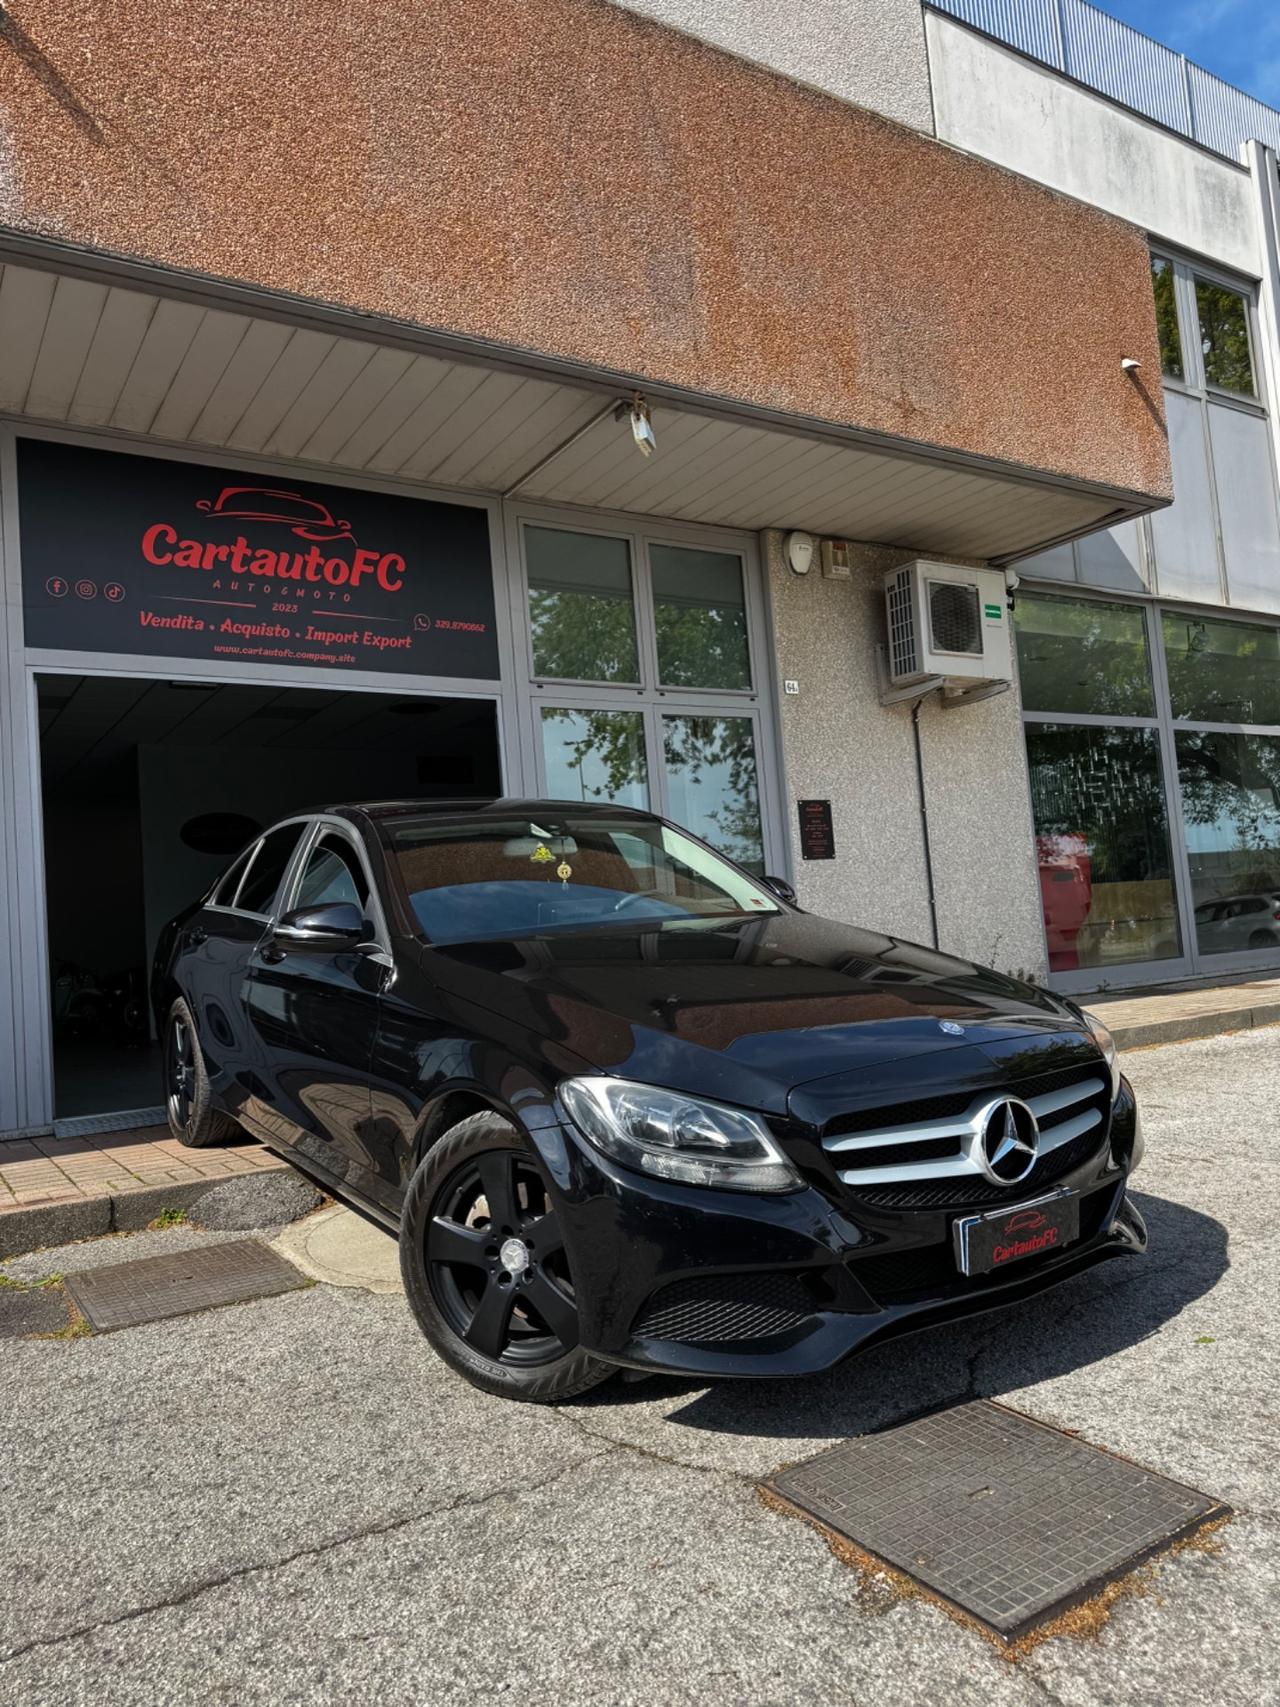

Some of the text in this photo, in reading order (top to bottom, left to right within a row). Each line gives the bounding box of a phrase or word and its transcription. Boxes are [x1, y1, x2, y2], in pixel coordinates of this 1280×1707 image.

[142, 523, 406, 591] CartautoFC
[272, 603, 298, 613] 2023
[139, 611, 412, 649] Vendita Acquisto Import Export
[993, 1227, 1057, 1263] CartautoFC
